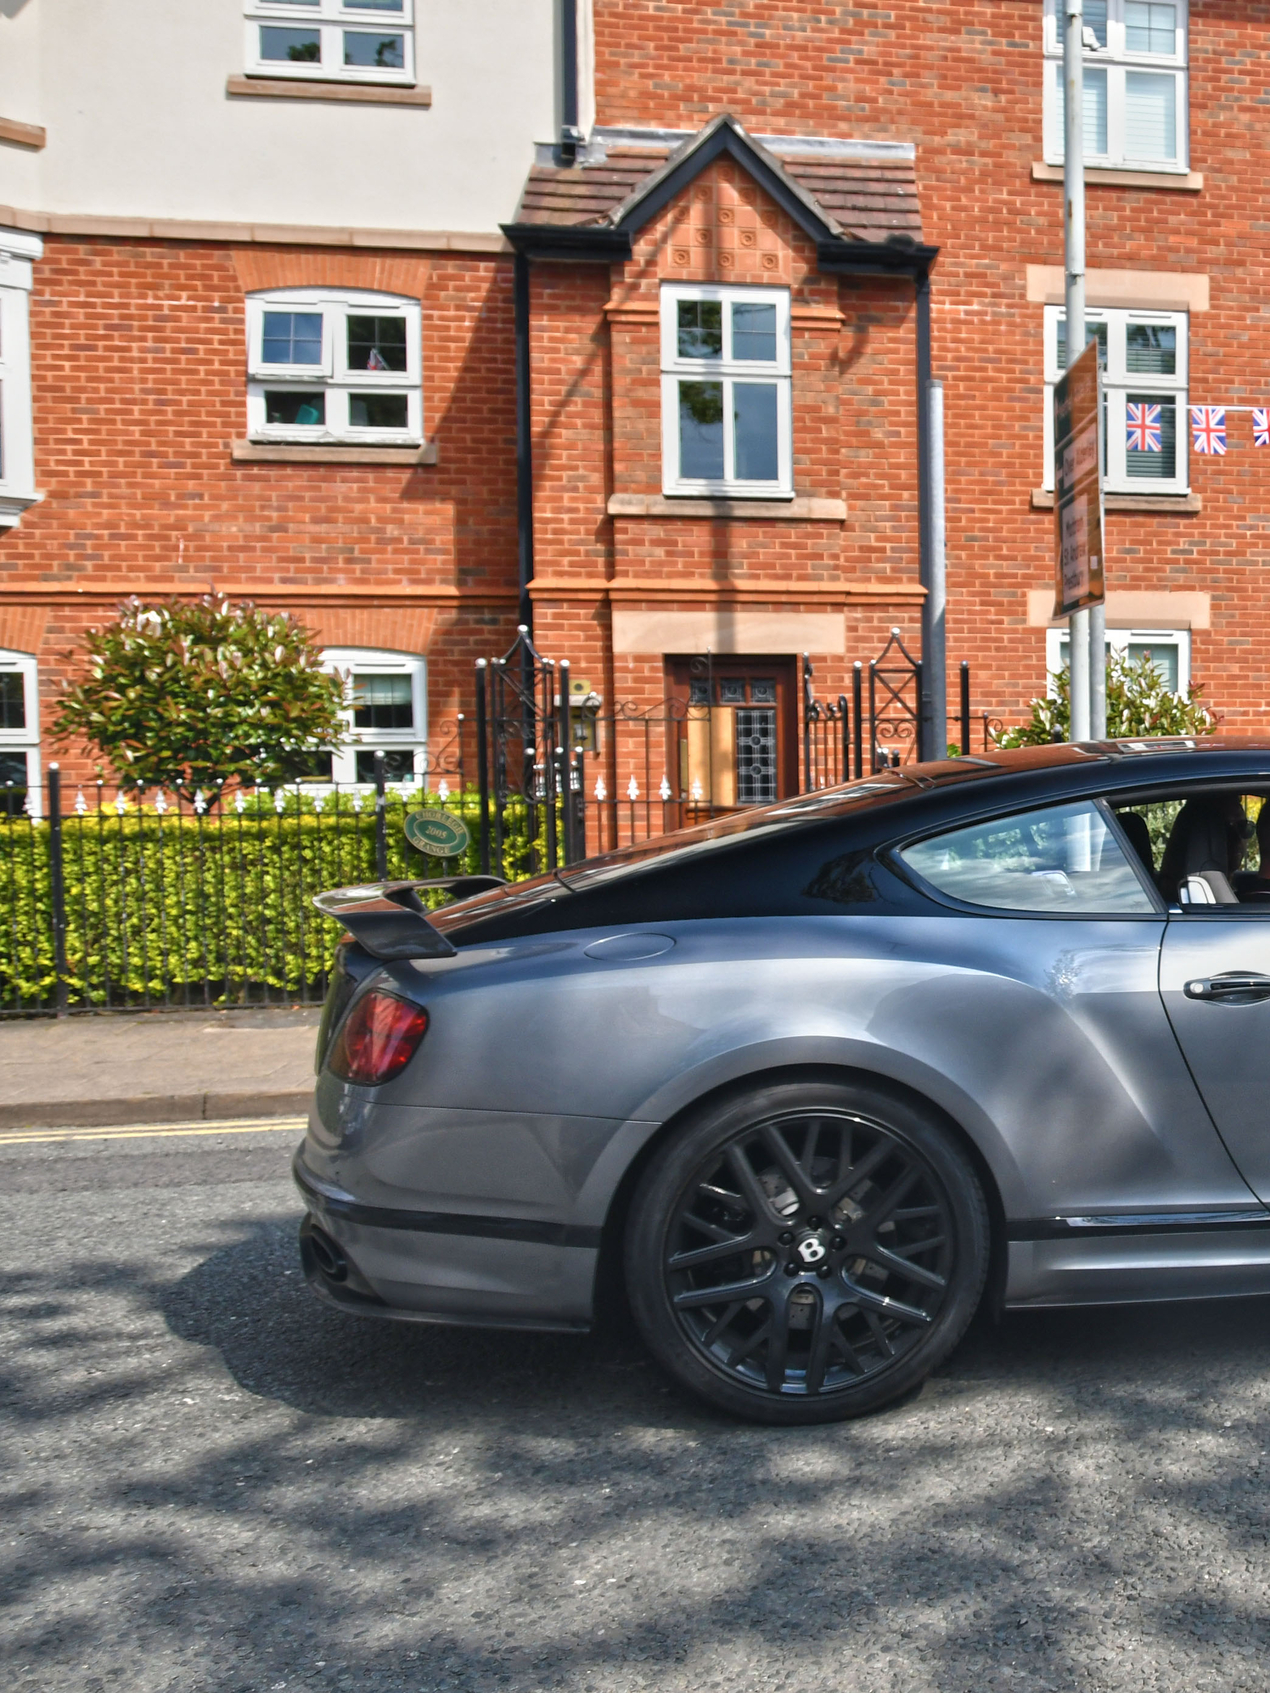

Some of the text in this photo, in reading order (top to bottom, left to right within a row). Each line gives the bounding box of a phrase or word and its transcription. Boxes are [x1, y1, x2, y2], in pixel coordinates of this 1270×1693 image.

[425, 825, 448, 839] 2005
[412, 836, 450, 854] GRANGE
[798, 1238, 826, 1263] B
